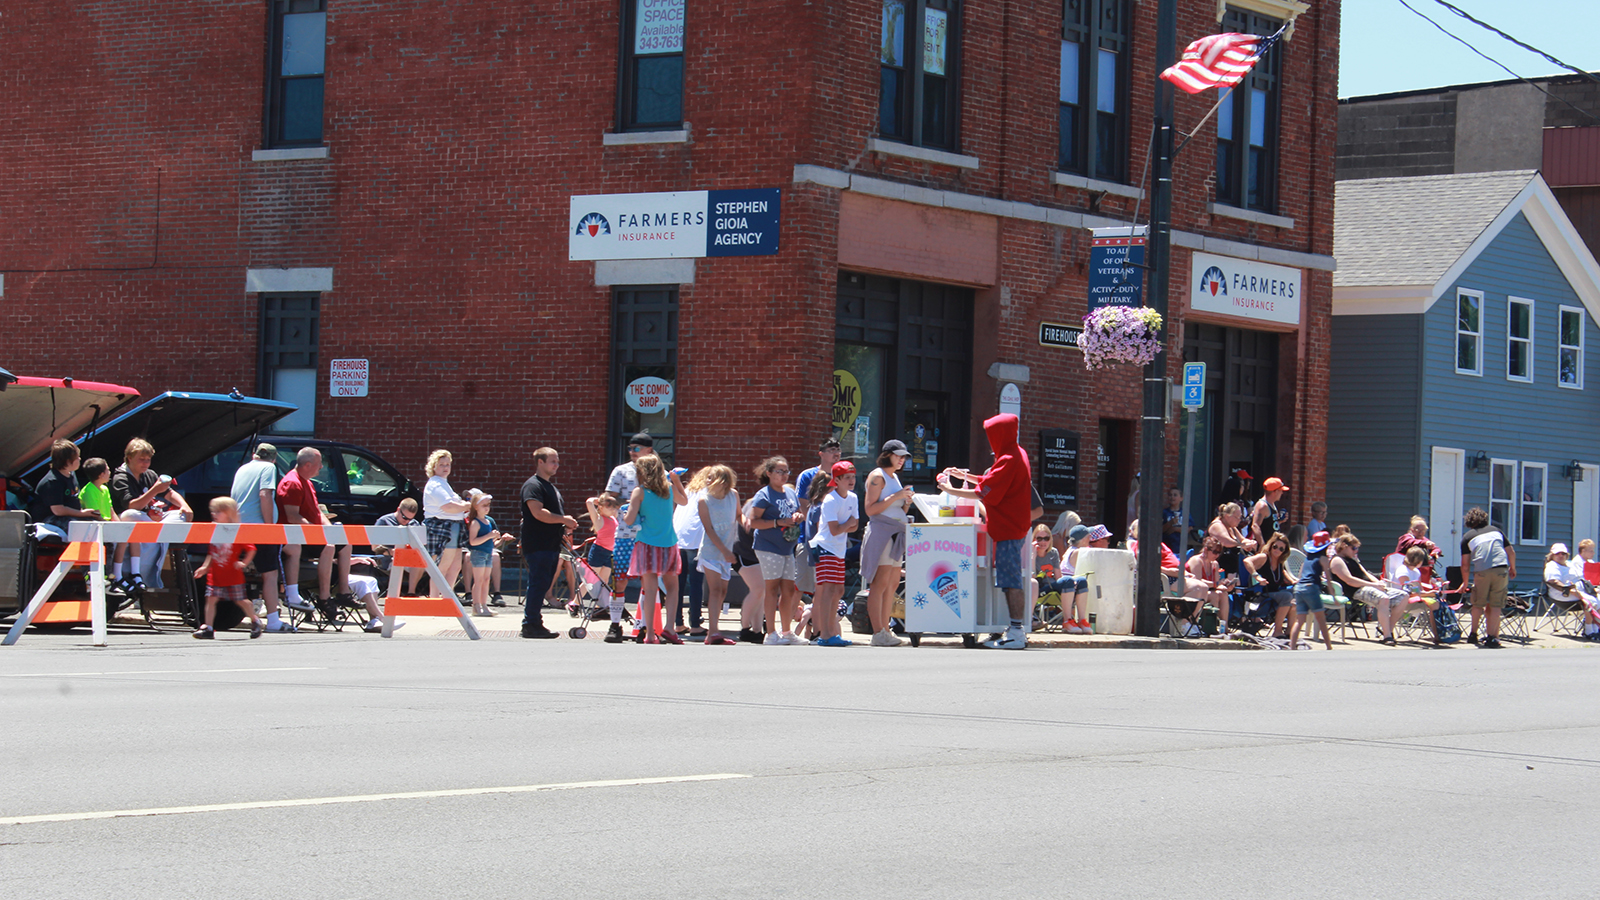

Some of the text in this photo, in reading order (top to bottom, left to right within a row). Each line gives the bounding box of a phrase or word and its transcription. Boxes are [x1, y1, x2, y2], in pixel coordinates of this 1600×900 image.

[644, 8, 683, 23] SPACE
[926, 15, 945, 29] FFICE
[640, 24, 684, 36] Available
[926, 27, 939, 39] FOR
[715, 201, 768, 215] STEPHEN
[618, 211, 704, 228] FARMERS
[715, 217, 748, 230] GIOIA
[618, 232, 675, 241] INSURANCE
[714, 232, 763, 246] AGENCY
[1233, 273, 1294, 298] FARMERS
[1232, 297, 1274, 311] INSURANCE
[333, 361, 367, 370] FIREHOUSE
[332, 371, 367, 379] PARKING
[338, 387, 359, 395] ONLY
[630, 384, 670, 395] THE COMIC
[833, 385, 857, 407] OMIC
[639, 396, 660, 407] SHOP
[1056, 438, 1066, 448] 112
[907, 540, 972, 557] SNO KONES
